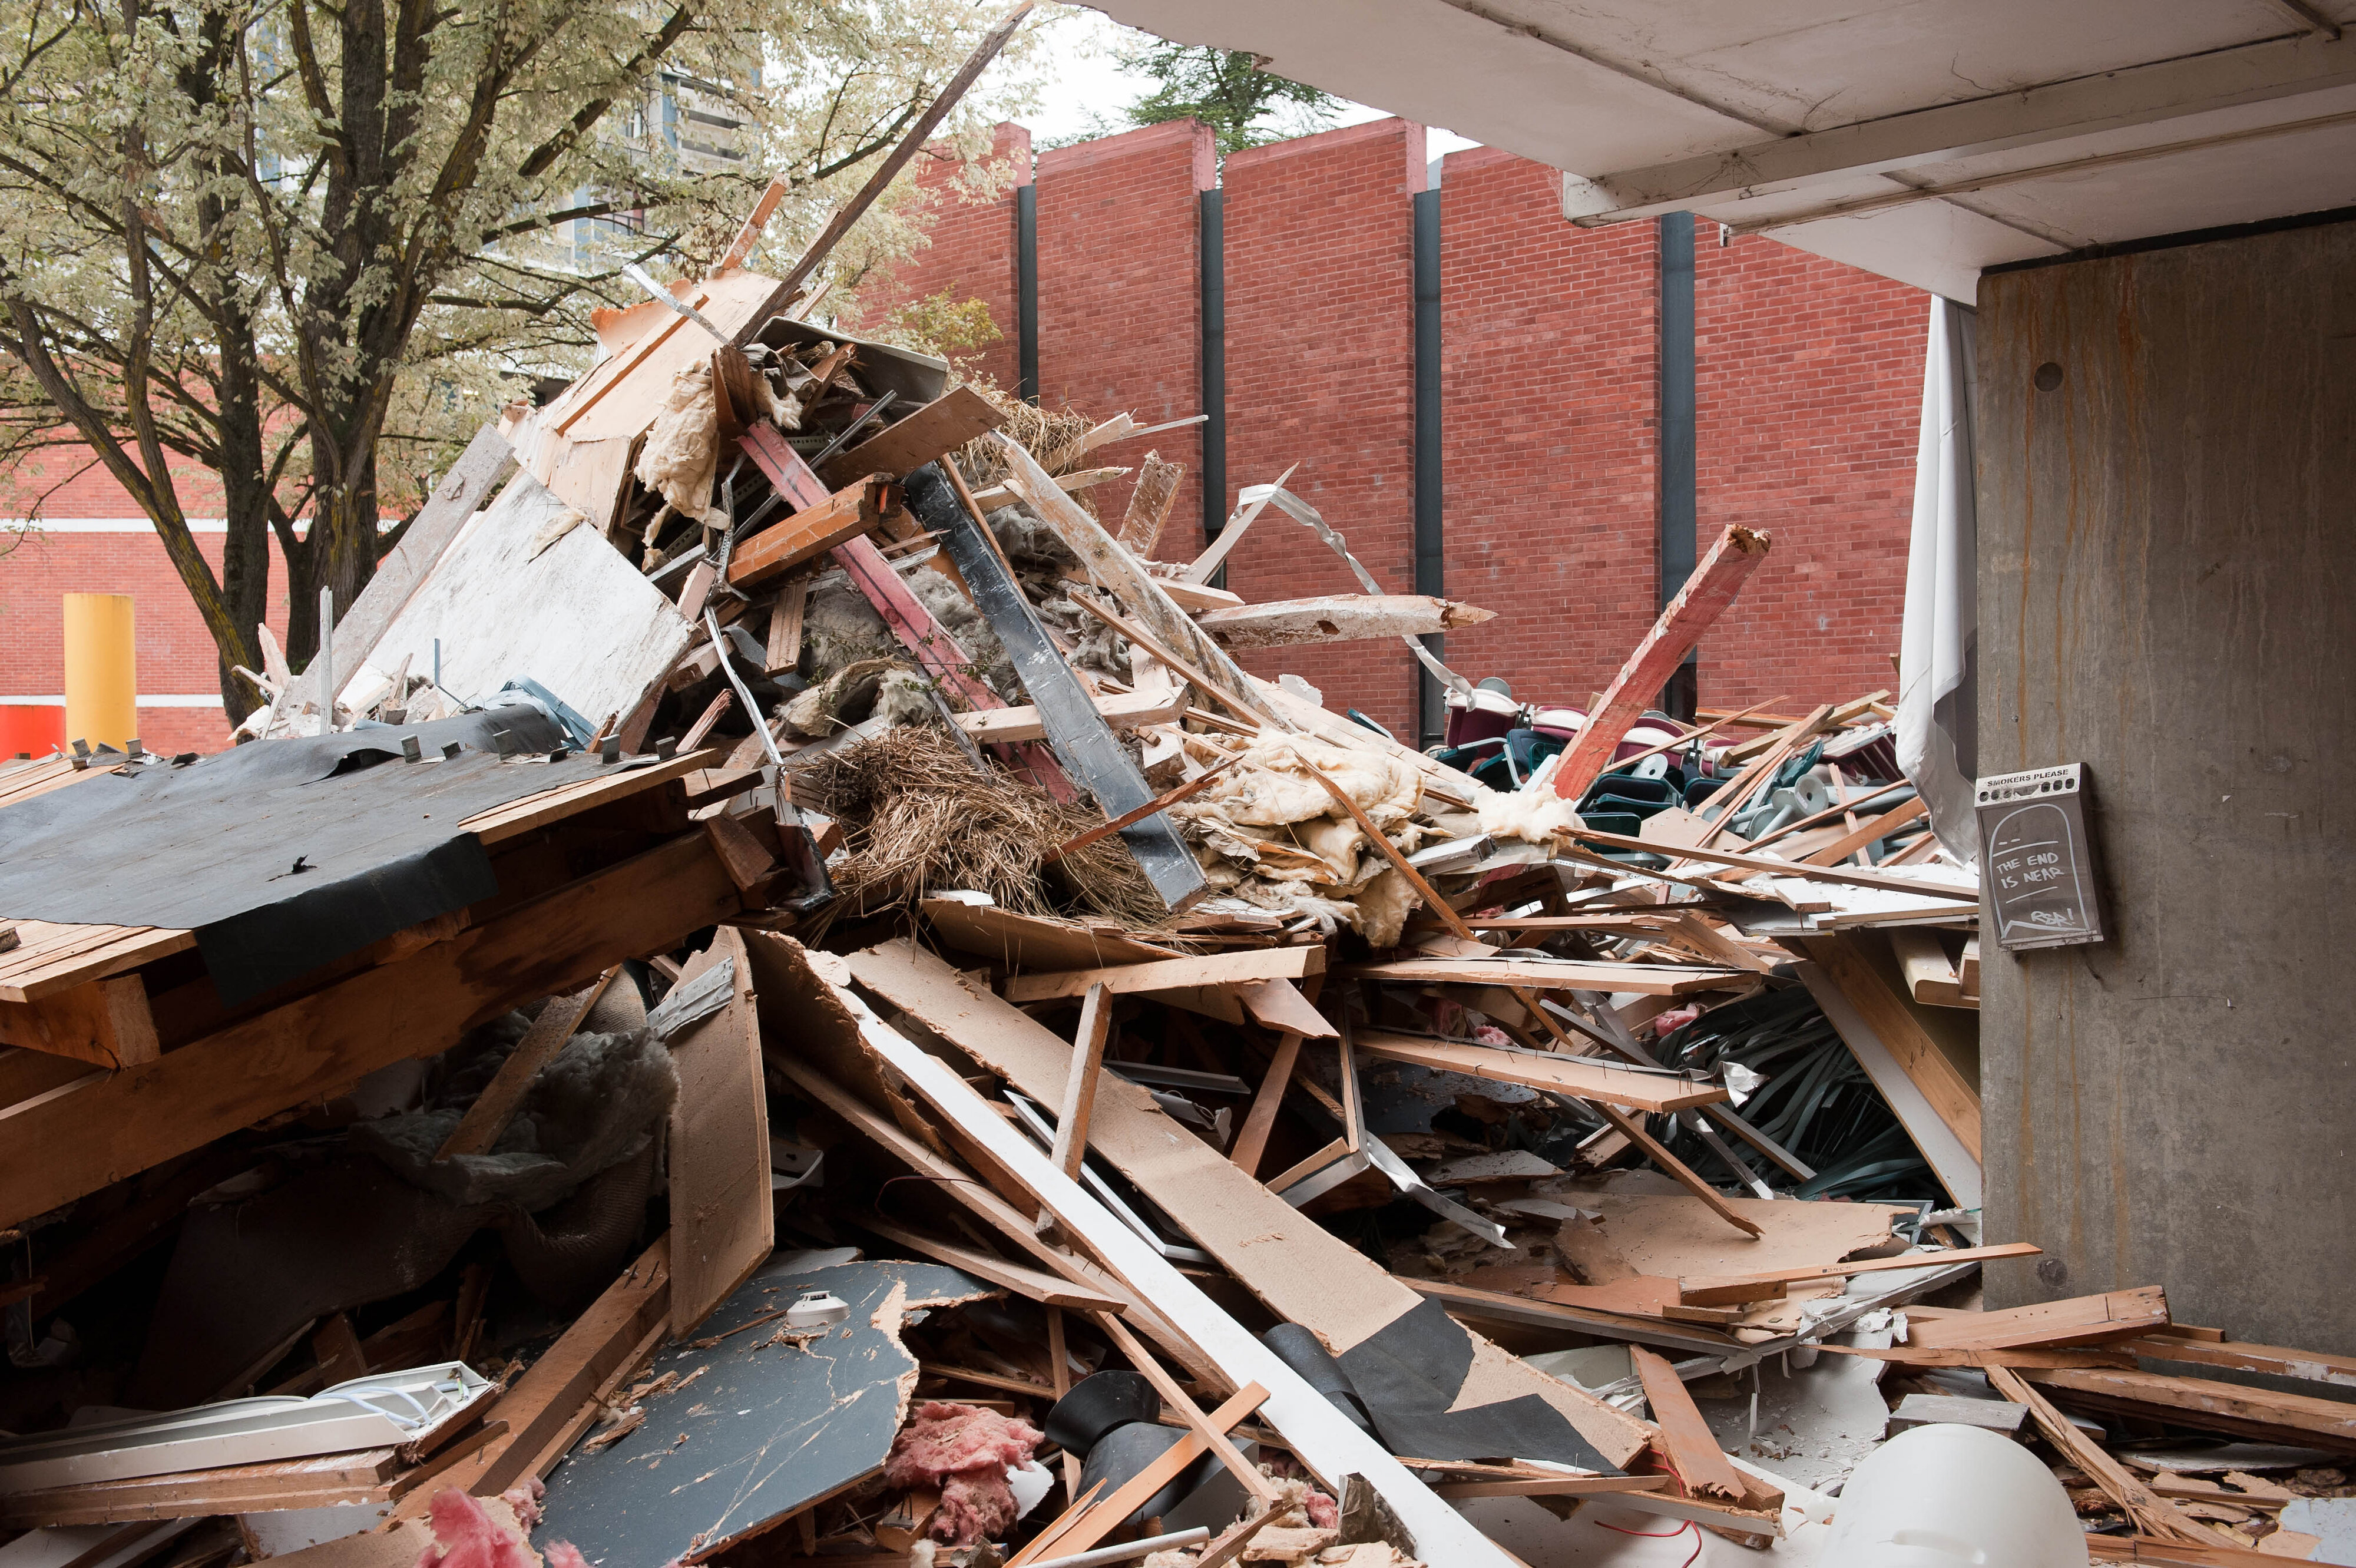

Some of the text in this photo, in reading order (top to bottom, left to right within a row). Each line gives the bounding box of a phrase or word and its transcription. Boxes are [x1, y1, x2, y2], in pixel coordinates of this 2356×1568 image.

[1987, 769, 2069, 786] SMOKERS PLEASE
[1996, 852, 2059, 874] THE END
[2001, 867, 2064, 889] IS NEAR
